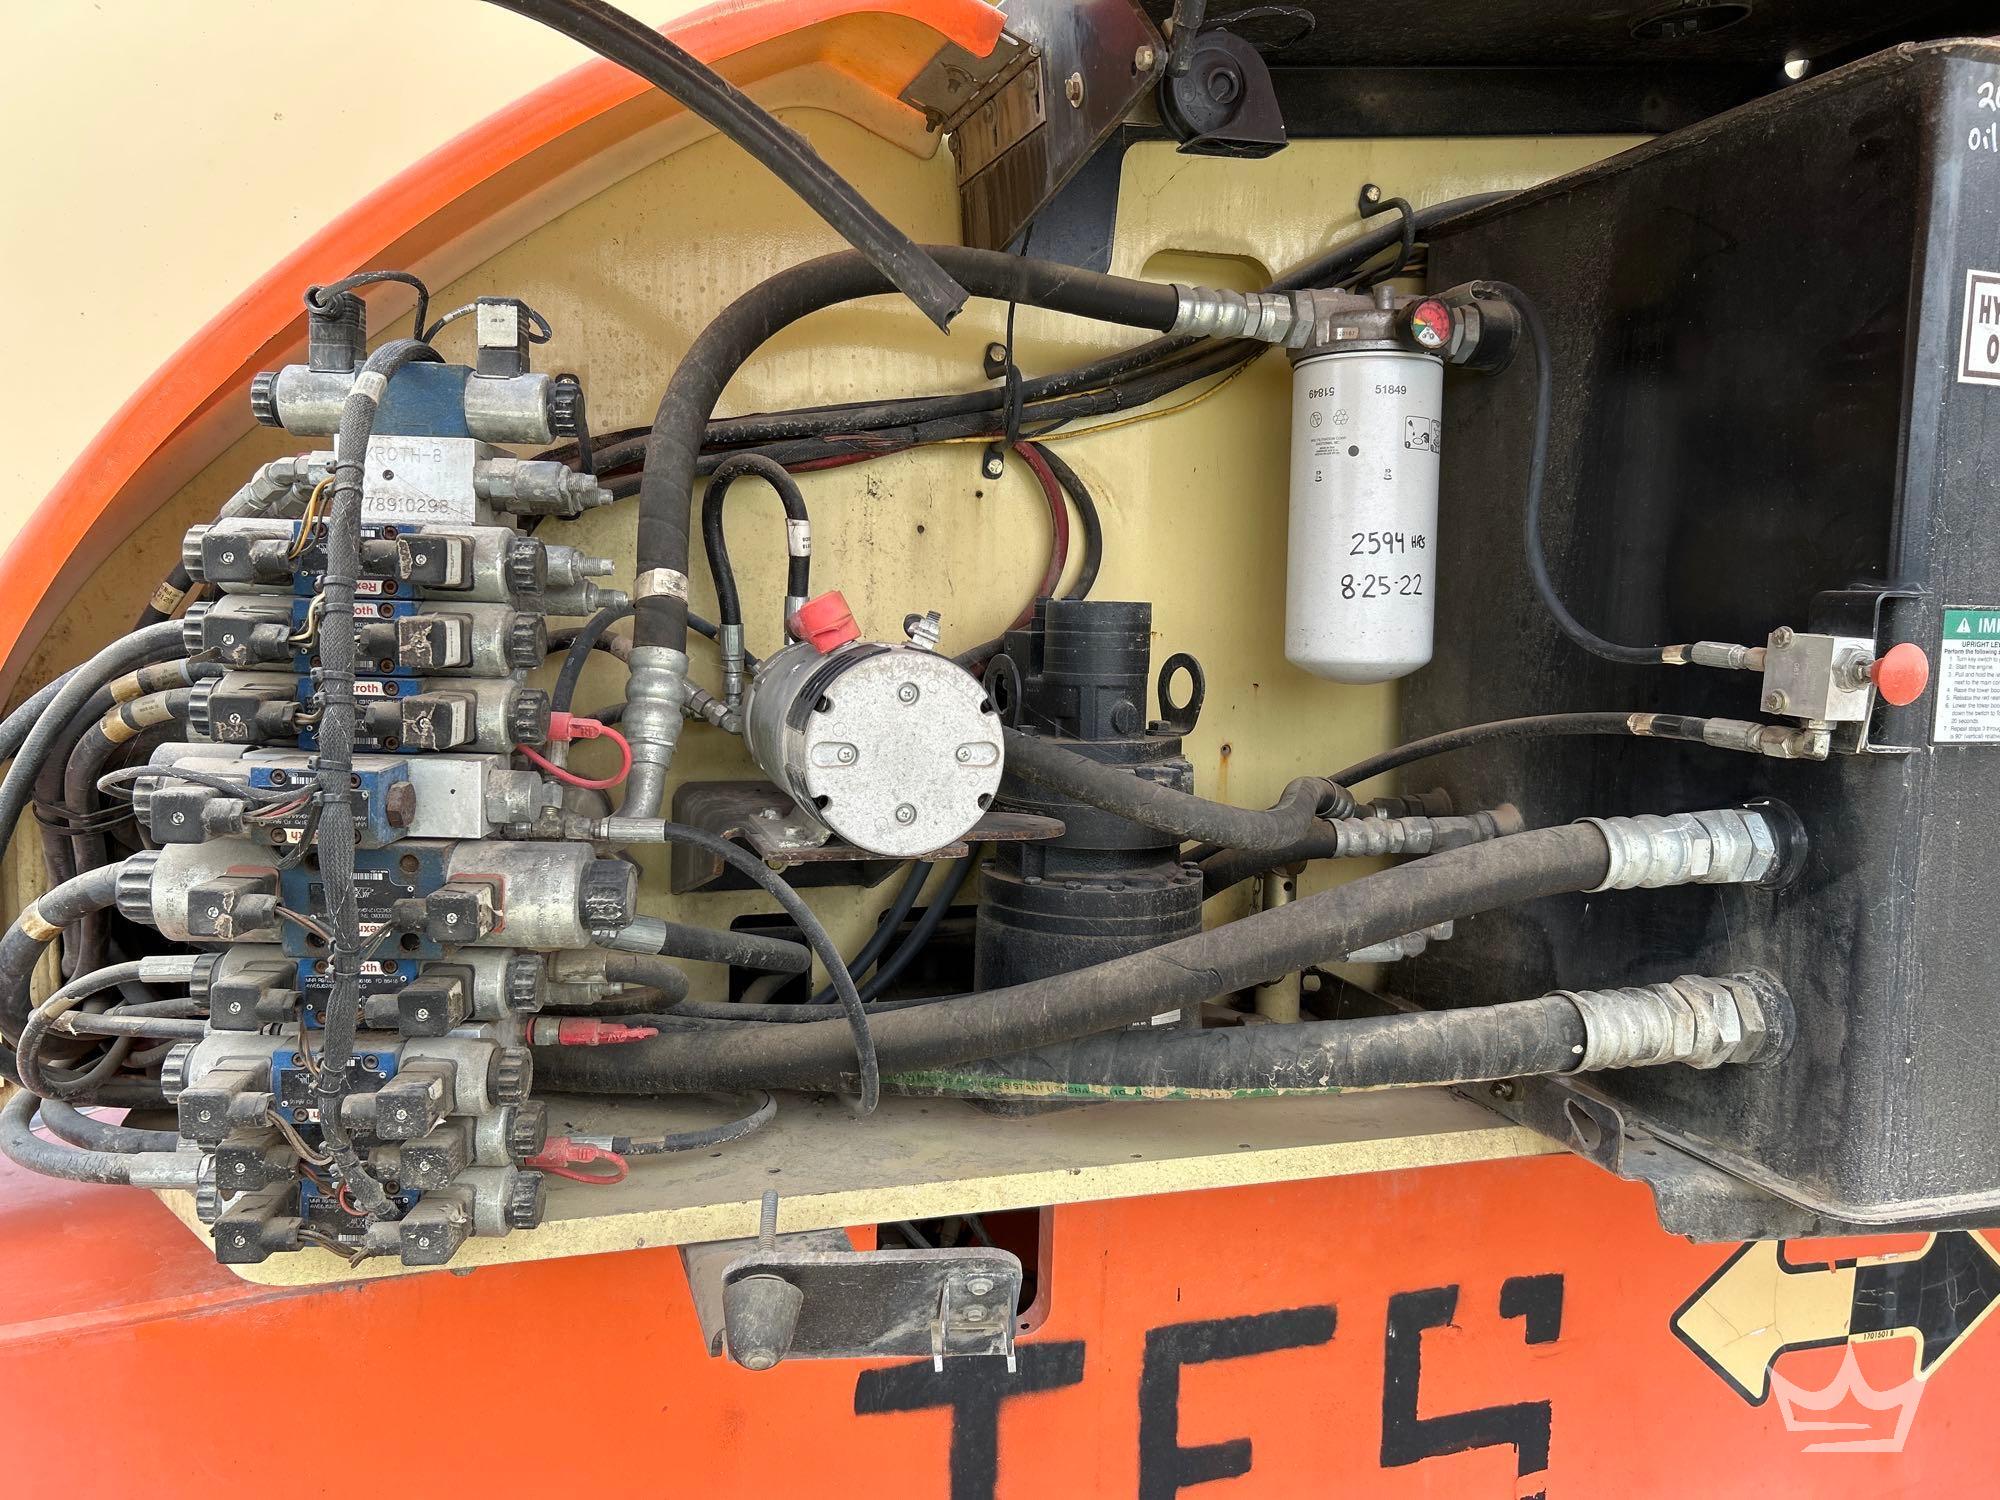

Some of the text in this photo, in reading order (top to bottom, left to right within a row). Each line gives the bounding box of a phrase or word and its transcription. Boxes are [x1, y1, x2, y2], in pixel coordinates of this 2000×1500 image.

[1308, 386, 1335, 399] 51849
[1375, 384, 1407, 395] 51849
[1349, 531, 1426, 556] 2594 HRS
[354, 605, 374, 615] oth
